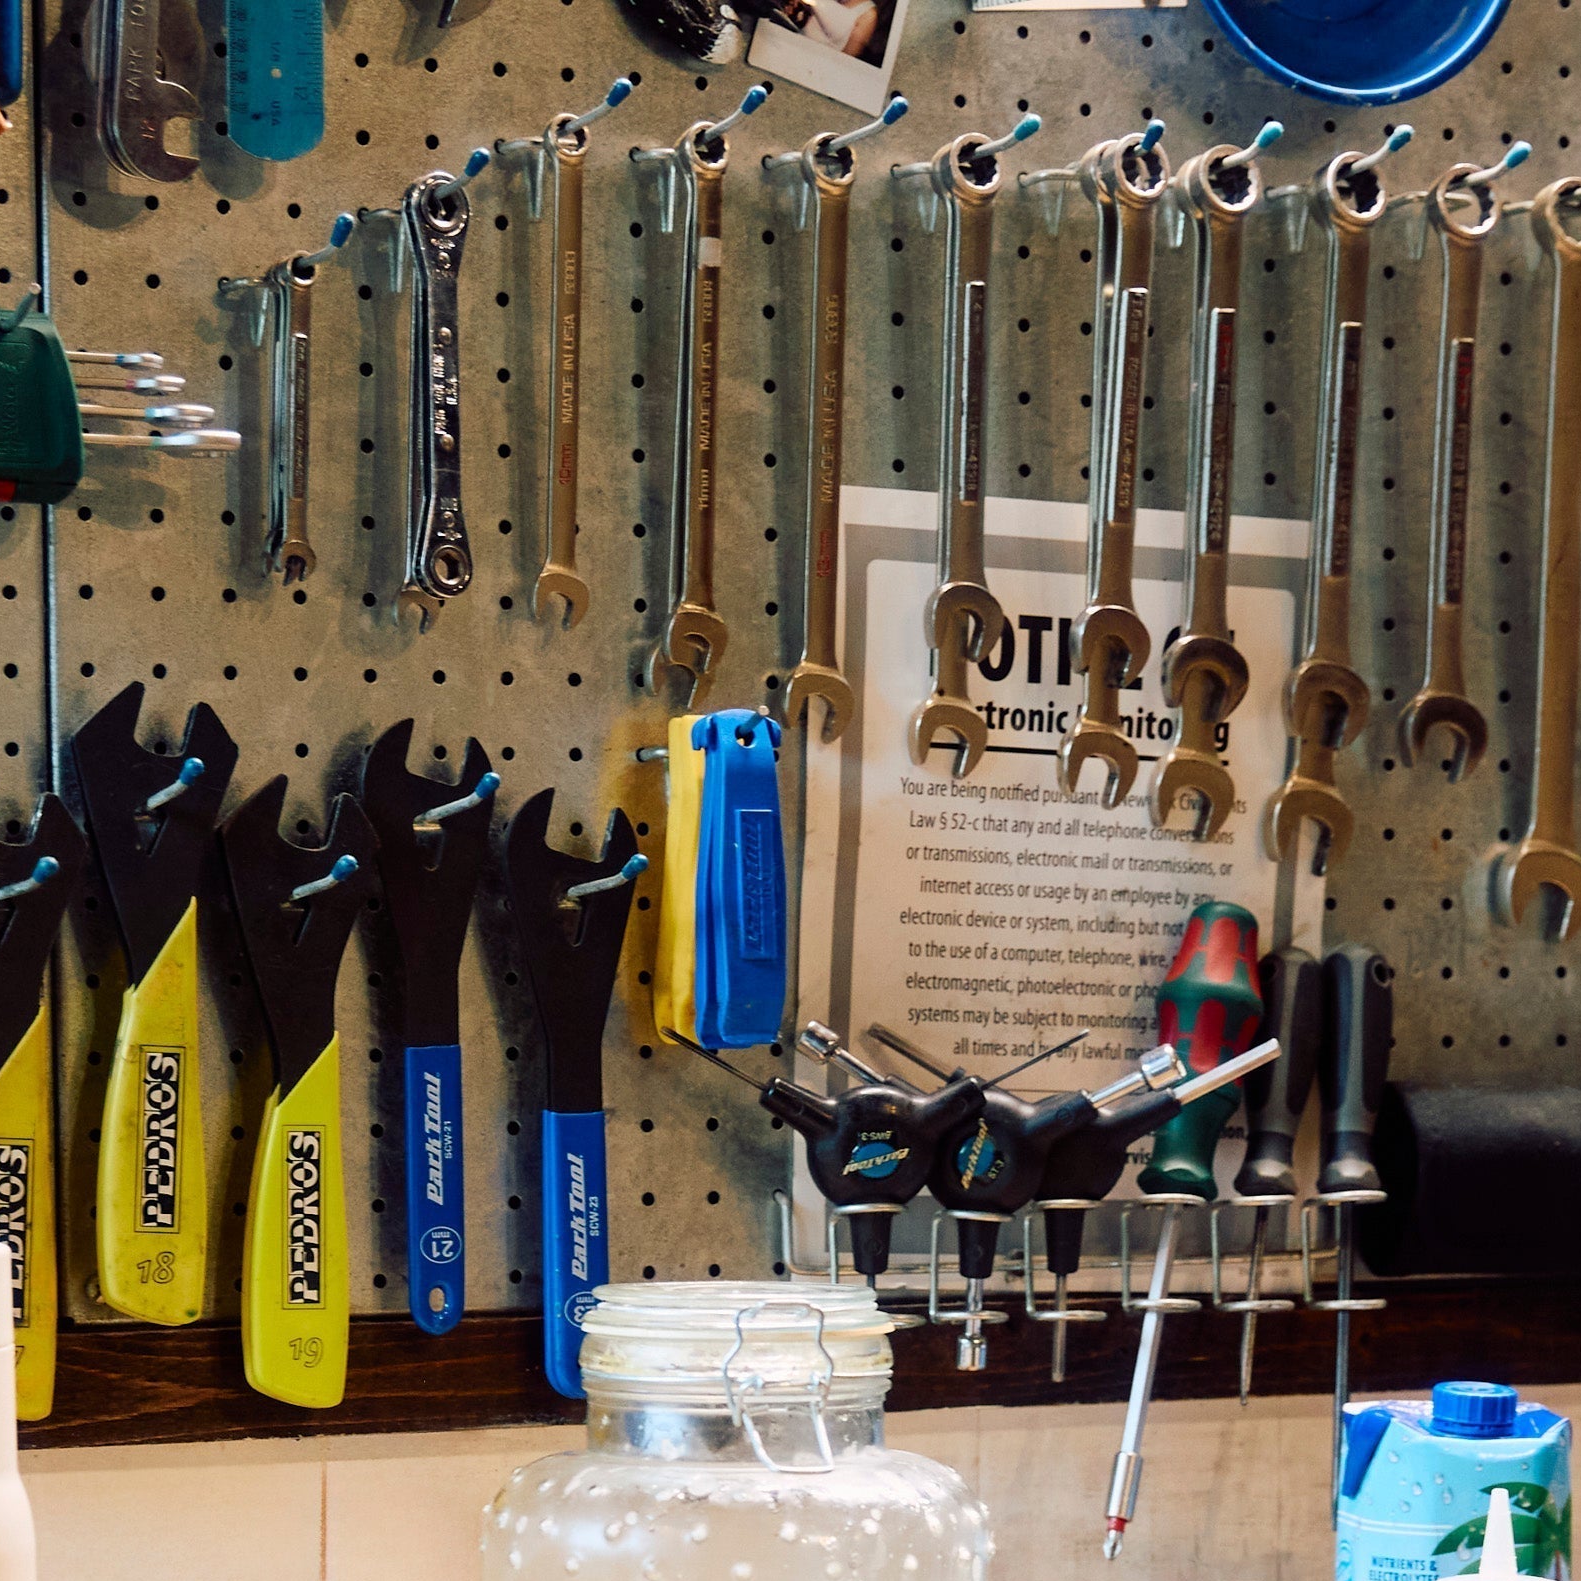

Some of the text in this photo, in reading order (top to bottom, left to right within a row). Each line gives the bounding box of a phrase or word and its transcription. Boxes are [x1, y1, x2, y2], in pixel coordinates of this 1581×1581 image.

[563, 313, 576, 350] USA
[563, 354, 575, 370] IN
[700, 341, 713, 377] USA
[562, 375, 575, 424] MADE
[700, 380, 712, 397] IN
[821, 368, 837, 412] USA
[699, 401, 712, 451] MADE
[821, 418, 836, 438] IN
[820, 444, 835, 503] MADE
[900, 778, 923, 796] You
[927, 782, 947, 797] are
[951, 780, 986, 802] being
[990, 783, 1039, 802] notified
[909, 810, 937, 828] Law
[951, 812, 979, 831] 52-c
[982, 814, 1008, 832] that
[1012, 818, 1034, 837] any
[1037, 816, 1062, 835] and
[1065, 816, 1080, 836] all
[1083, 819, 1147, 842] telephone
[906, 844, 1232, 877] or transmissions, electronic mail or transmissions, or
[920, 875, 971, 895] internet
[974, 882, 1015, 898] access
[1017, 884, 1031, 898] or
[1034, 886, 1070, 904] usage
[1074, 884, 1088, 904] by
[1091, 888, 1108, 902] an
[1111, 886, 1171, 908] employee
[1174, 888, 1190, 909] by
[900, 908, 1183, 939] electronic device or system, including but not
[908, 942, 922, 957] to
[925, 941, 947, 959] the
[950, 946, 971, 960] use
[974, 943, 989, 960] of
[991, 949, 998, 961] a
[1002, 948, 1065, 968] computer,
[1068, 948, 1136, 970] telephone,
[1139, 952, 1170, 970] wire,
[906, 975, 1014, 997] electromagnetic,
[1017, 977, 1117, 1000] photoelectronic
[1120, 984, 1132, 998] or
[908, 1007, 960, 1027] systems
[963, 1010, 990, 1029] may
[993, 1007, 1008, 1024] be
[1013, 1009, 1058, 1031] subject
[1061, 1012, 1074, 1027] to
[1077, 1013, 1147, 1034] monitoring
[953, 1039, 969, 1055] all
[973, 1041, 1008, 1058] times
[1011, 1041, 1035, 1058] and
[1082, 1042, 1123, 1060] lawful
[143, 1051, 180, 1229] PEDRO'S
[444, 1119, 453, 1159] SCW-21
[288, 1130, 322, 1305] PEDRO'S
[590, 1195, 600, 1237] SCW-23
[431, 1240, 455, 1259] 21
[136, 1250, 176, 1285] 18
[289, 1336, 325, 1369] 19
[1371, 1556, 1437, 1572] NUTRIENTS &
